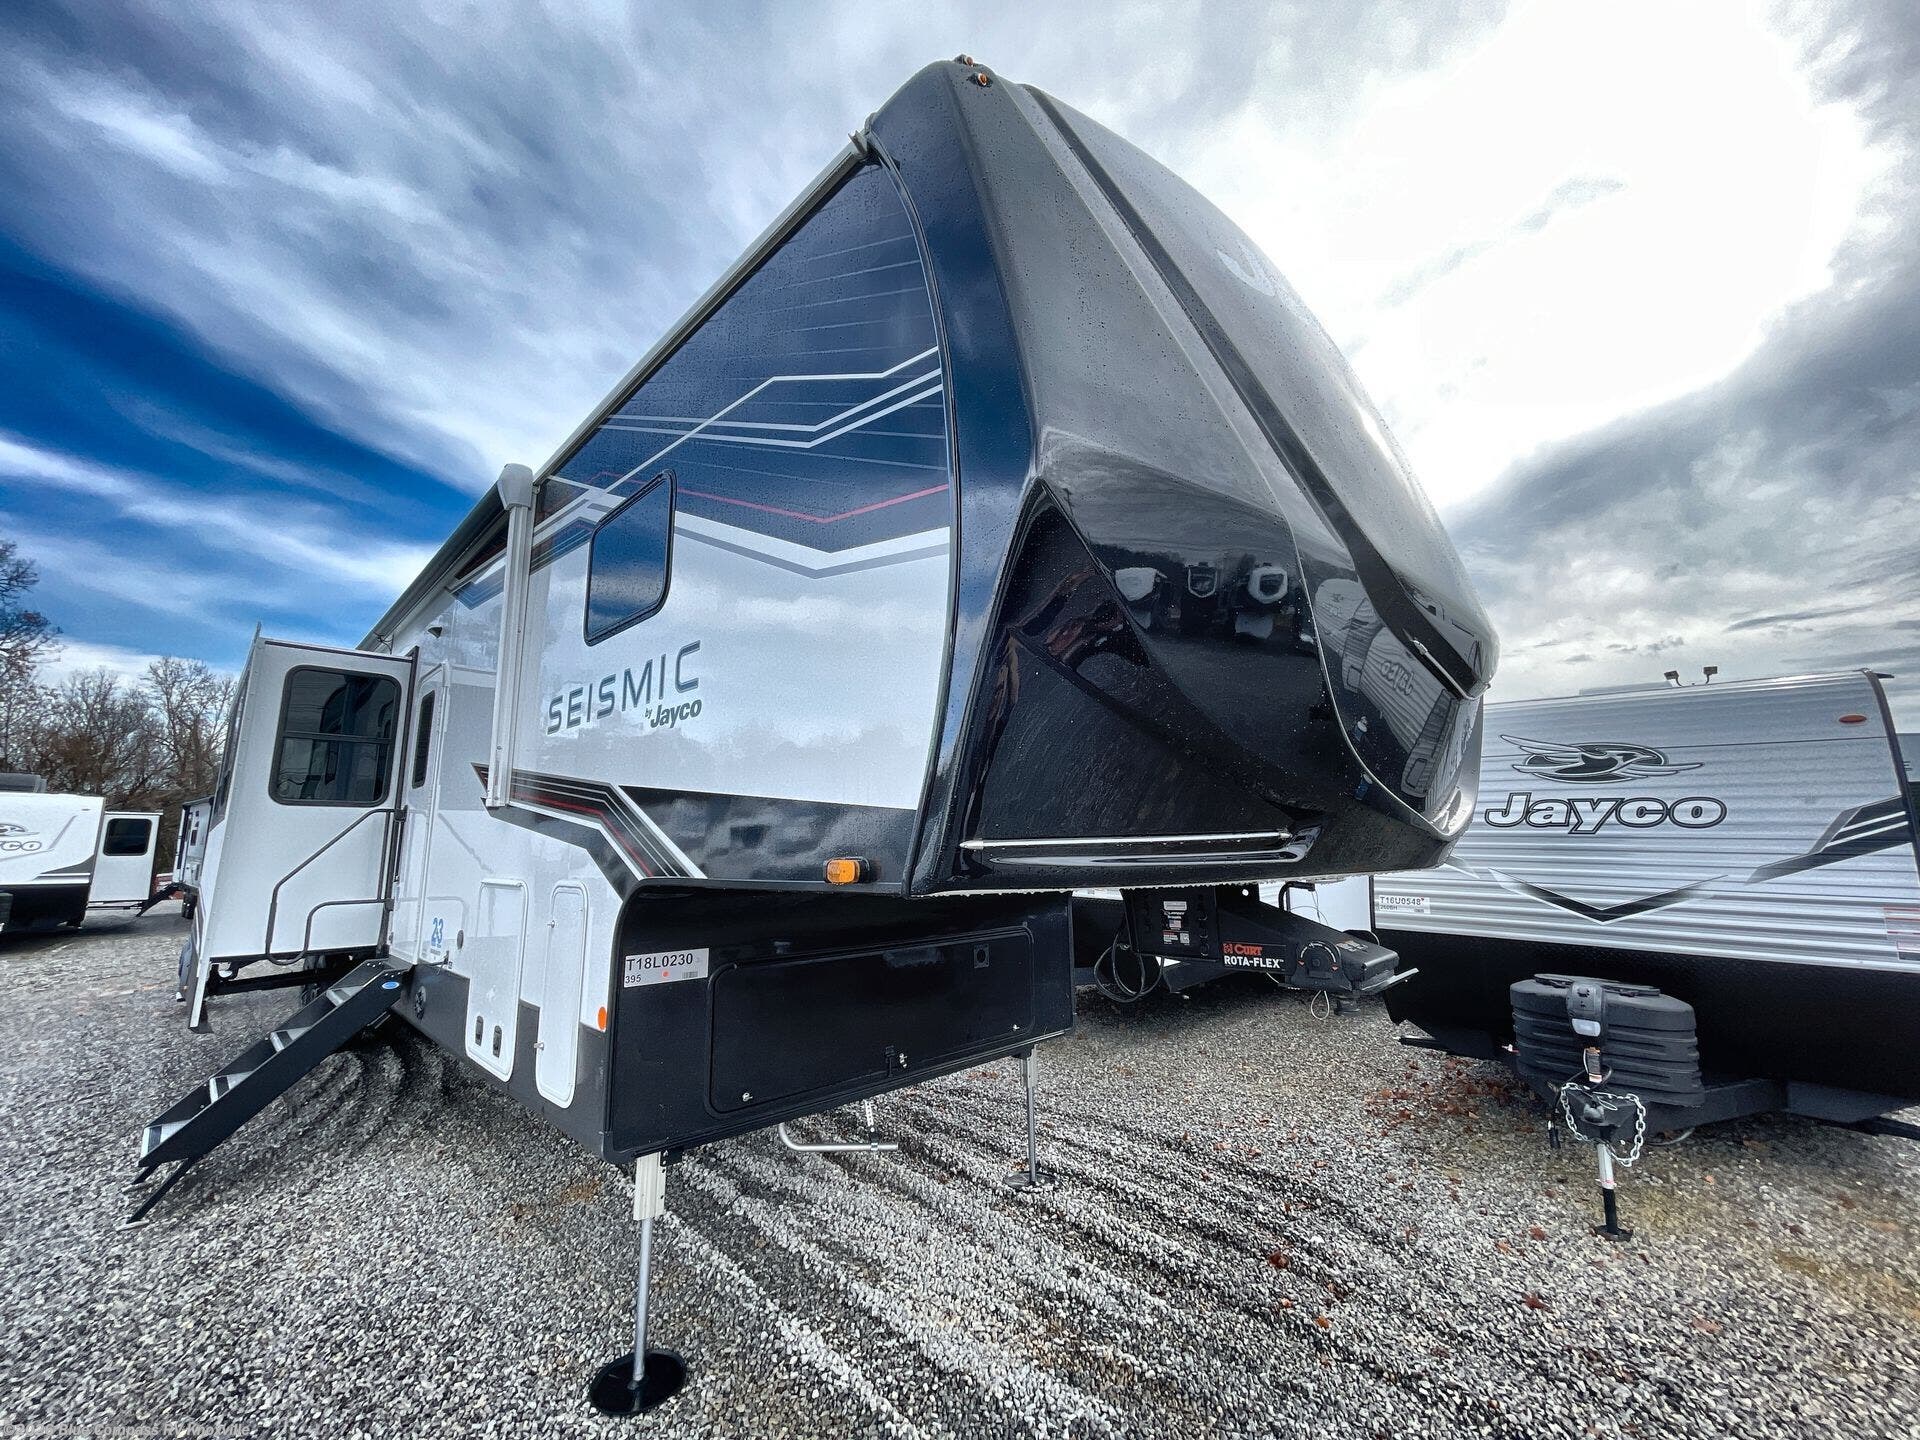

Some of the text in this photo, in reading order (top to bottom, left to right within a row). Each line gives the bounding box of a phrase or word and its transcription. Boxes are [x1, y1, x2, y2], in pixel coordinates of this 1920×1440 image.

[547, 640, 701, 735] SEISMIC
[644, 699, 703, 729] by Jayco
[1484, 792, 1728, 835] Jayco
[1234, 944, 1263, 955] CURT
[626, 953, 694, 971] T18L0230
[625, 974, 642, 984] 395
